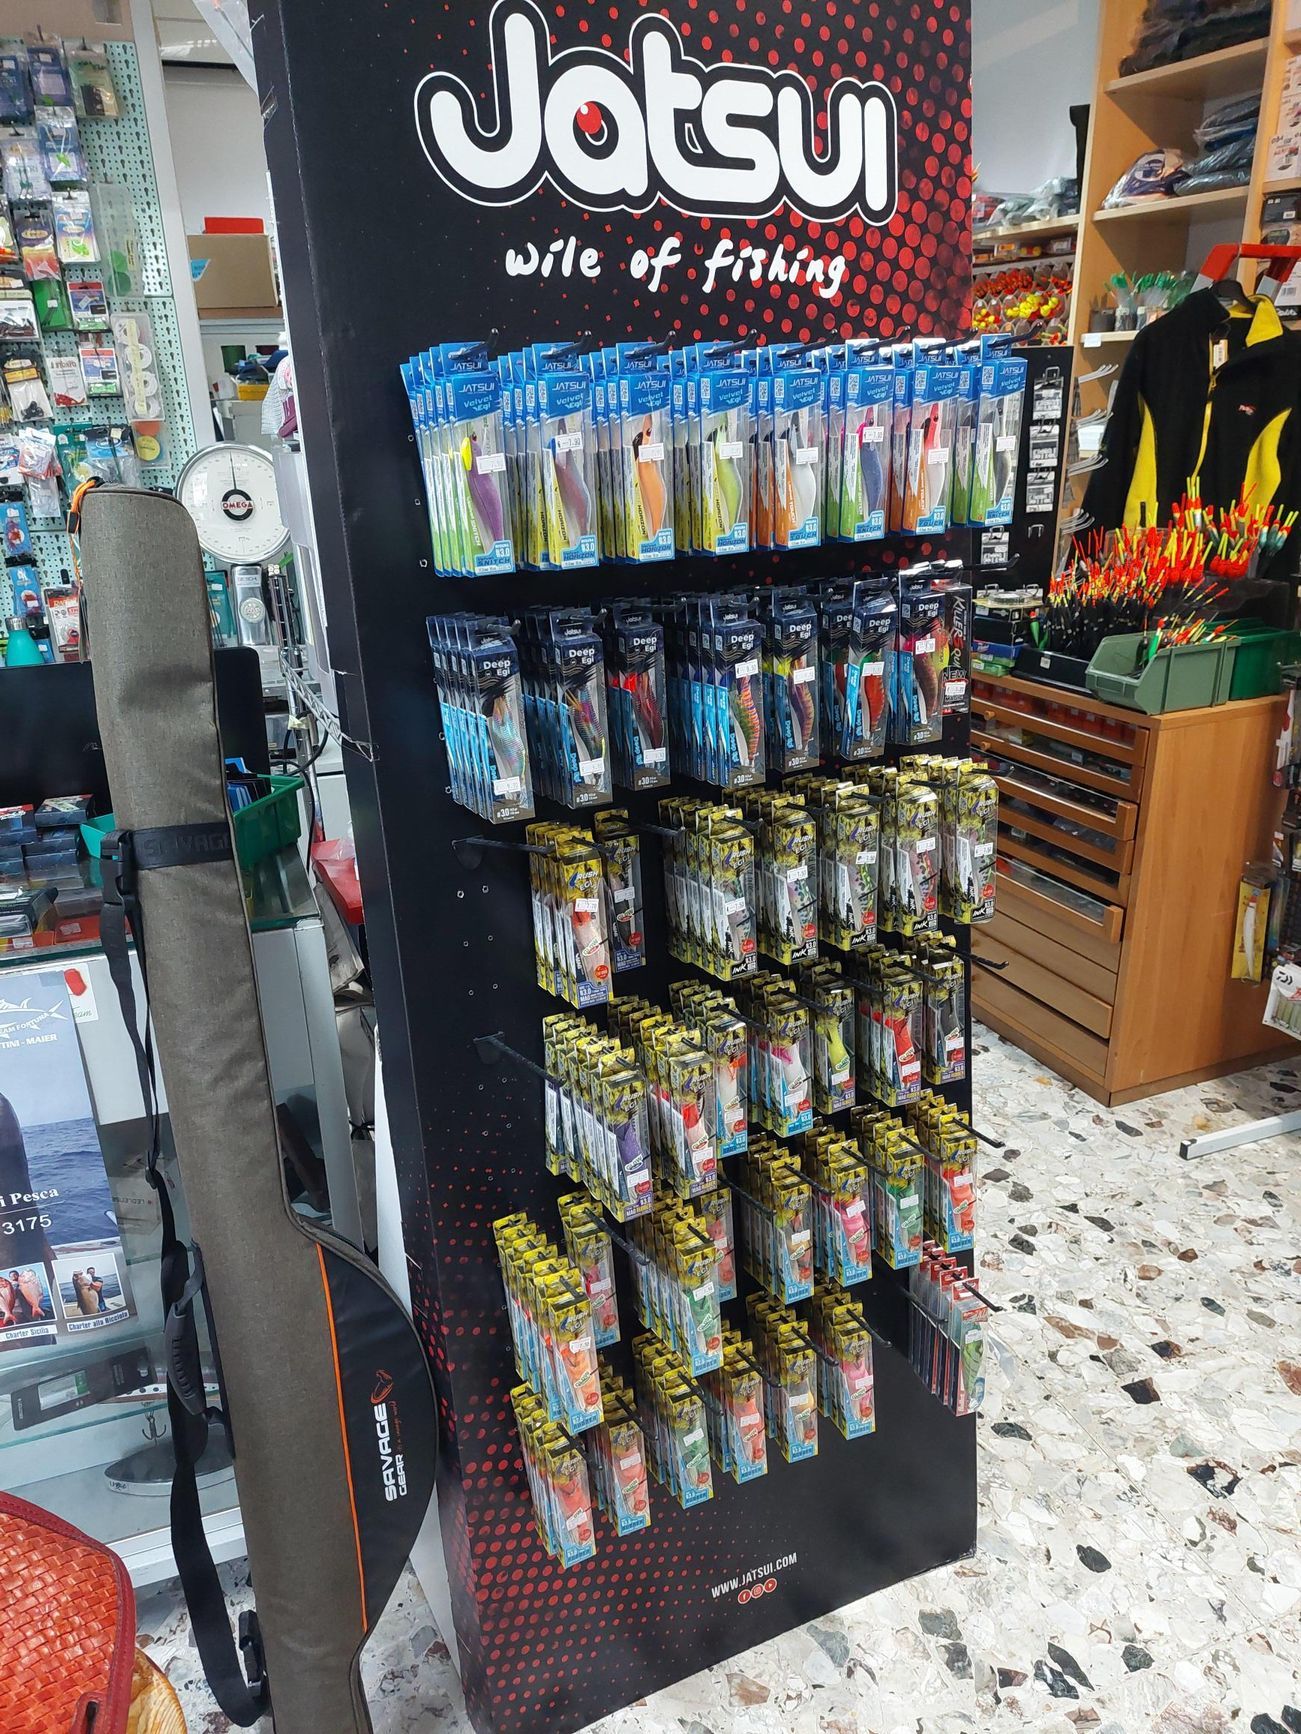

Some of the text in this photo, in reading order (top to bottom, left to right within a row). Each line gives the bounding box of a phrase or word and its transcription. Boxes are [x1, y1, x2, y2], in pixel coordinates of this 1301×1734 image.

[505, 235, 847, 299] wile of fishing
[1000, 366, 1024, 375] JATSUI
[864, 374, 892, 384] JATSUI
[932, 372, 959, 380] JATSUI
[459, 382, 495, 393] JATSUI
[552, 380, 587, 390] JATSUI
[634, 380, 667, 390] JATSUI
[716, 378, 746, 388] JATSUI
[790, 378, 818, 388] JATSUI
[222, 502, 253, 510] OMEGA
[918, 602, 940, 612] Deep
[836, 614, 852, 622] Dee
[869, 618, 891, 628] Deep
[790, 623, 812, 632] Deep
[633, 636, 658, 646] Deep
[731, 634, 754, 644] Deep
[800, 632, 811, 640] Egi
[742, 642, 754, 650] Egi
[568, 648, 595, 658] Deep
[483, 659, 511, 670] Deep
[582, 656, 595, 665] Egi
[496, 668, 511, 676] Egi
[972, 908, 986, 916] INK
[914, 922, 928, 931] INK
[852, 936, 867, 944] INK
[792, 948, 808, 958] INK
[732, 964, 748, 973] INK
[26, 1034, 58, 1046] MAIER
[11, 1188, 60, 1206] Pesca
[2, 1214, 52, 1236] 3175
[68, 1310, 128, 1331] Charter alla Ricciola
[6, 1326, 50, 1340] Charter Sicilia
[374, 1402, 398, 1502] SAVAGE
[395, 1454, 408, 1496] GEAR
[712, 1552, 798, 1598] WWW.JATSUI.COM
